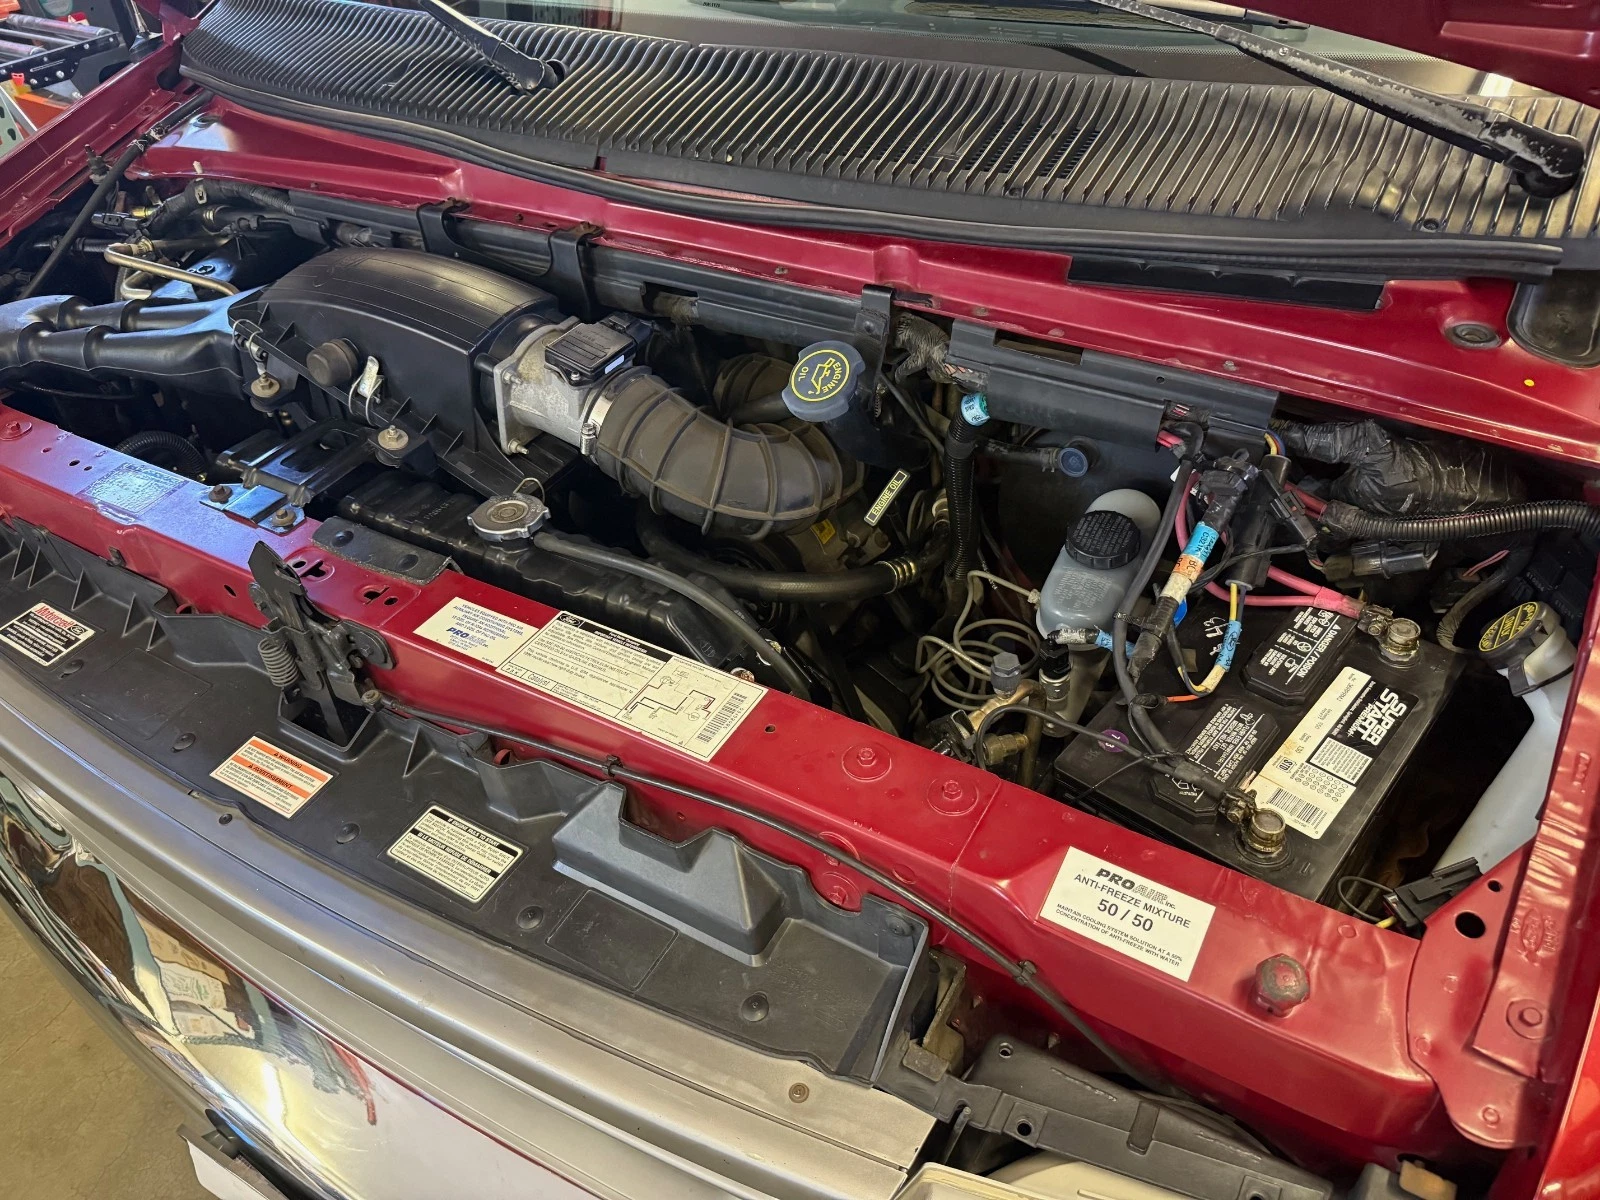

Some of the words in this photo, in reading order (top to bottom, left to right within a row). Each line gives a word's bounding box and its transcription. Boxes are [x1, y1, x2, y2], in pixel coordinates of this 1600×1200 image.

[797, 366, 809, 381] OIL
[821, 361, 842, 393] ENGINE
[872, 489, 890, 516] ENGINE
[889, 479, 902, 491] OIL
[446, 626, 470, 638] PRO
[1315, 627, 1337, 654] DANGER
[526, 673, 551, 686] Catalyst
[1296, 654, 1317, 679] POISON
[1345, 702, 1374, 735] PREMIUM
[1351, 687, 1401, 741] START
[1364, 699, 1408, 747] SUPER
[1231, 734, 1241, 745] EYES
[277, 753, 303, 768] WARNING
[252, 765, 293, 789] AVERTISSEMENT
[451, 819, 468, 830] ENGINE
[466, 827, 480, 836] FAILS
[484, 837, 499, 847] START
[426, 837, 446, 849] MOTEUR
[444, 846, 462, 858] REFUSE
[1073, 872, 1141, 908] ANTI-FREEZE
[1142, 901, 1191, 928] MIXTURE
[1056, 903, 1082, 917] MAINTAIN
[1081, 914, 1106, 928] COOLING
[1106, 924, 1129, 938] SYSTEM
[1128, 934, 1157, 951] SOLUTION
[1096, 897, 1119, 917] 50
[1119, 907, 1130, 922] /
[1130, 912, 1154, 932] 50
[1054, 908, 1100, 932] CONCENTRATION
[1108, 932, 1144, 951] ANTI-FREEZE
[1144, 947, 1159, 958] WITH
[1158, 953, 1180, 967] WATER
